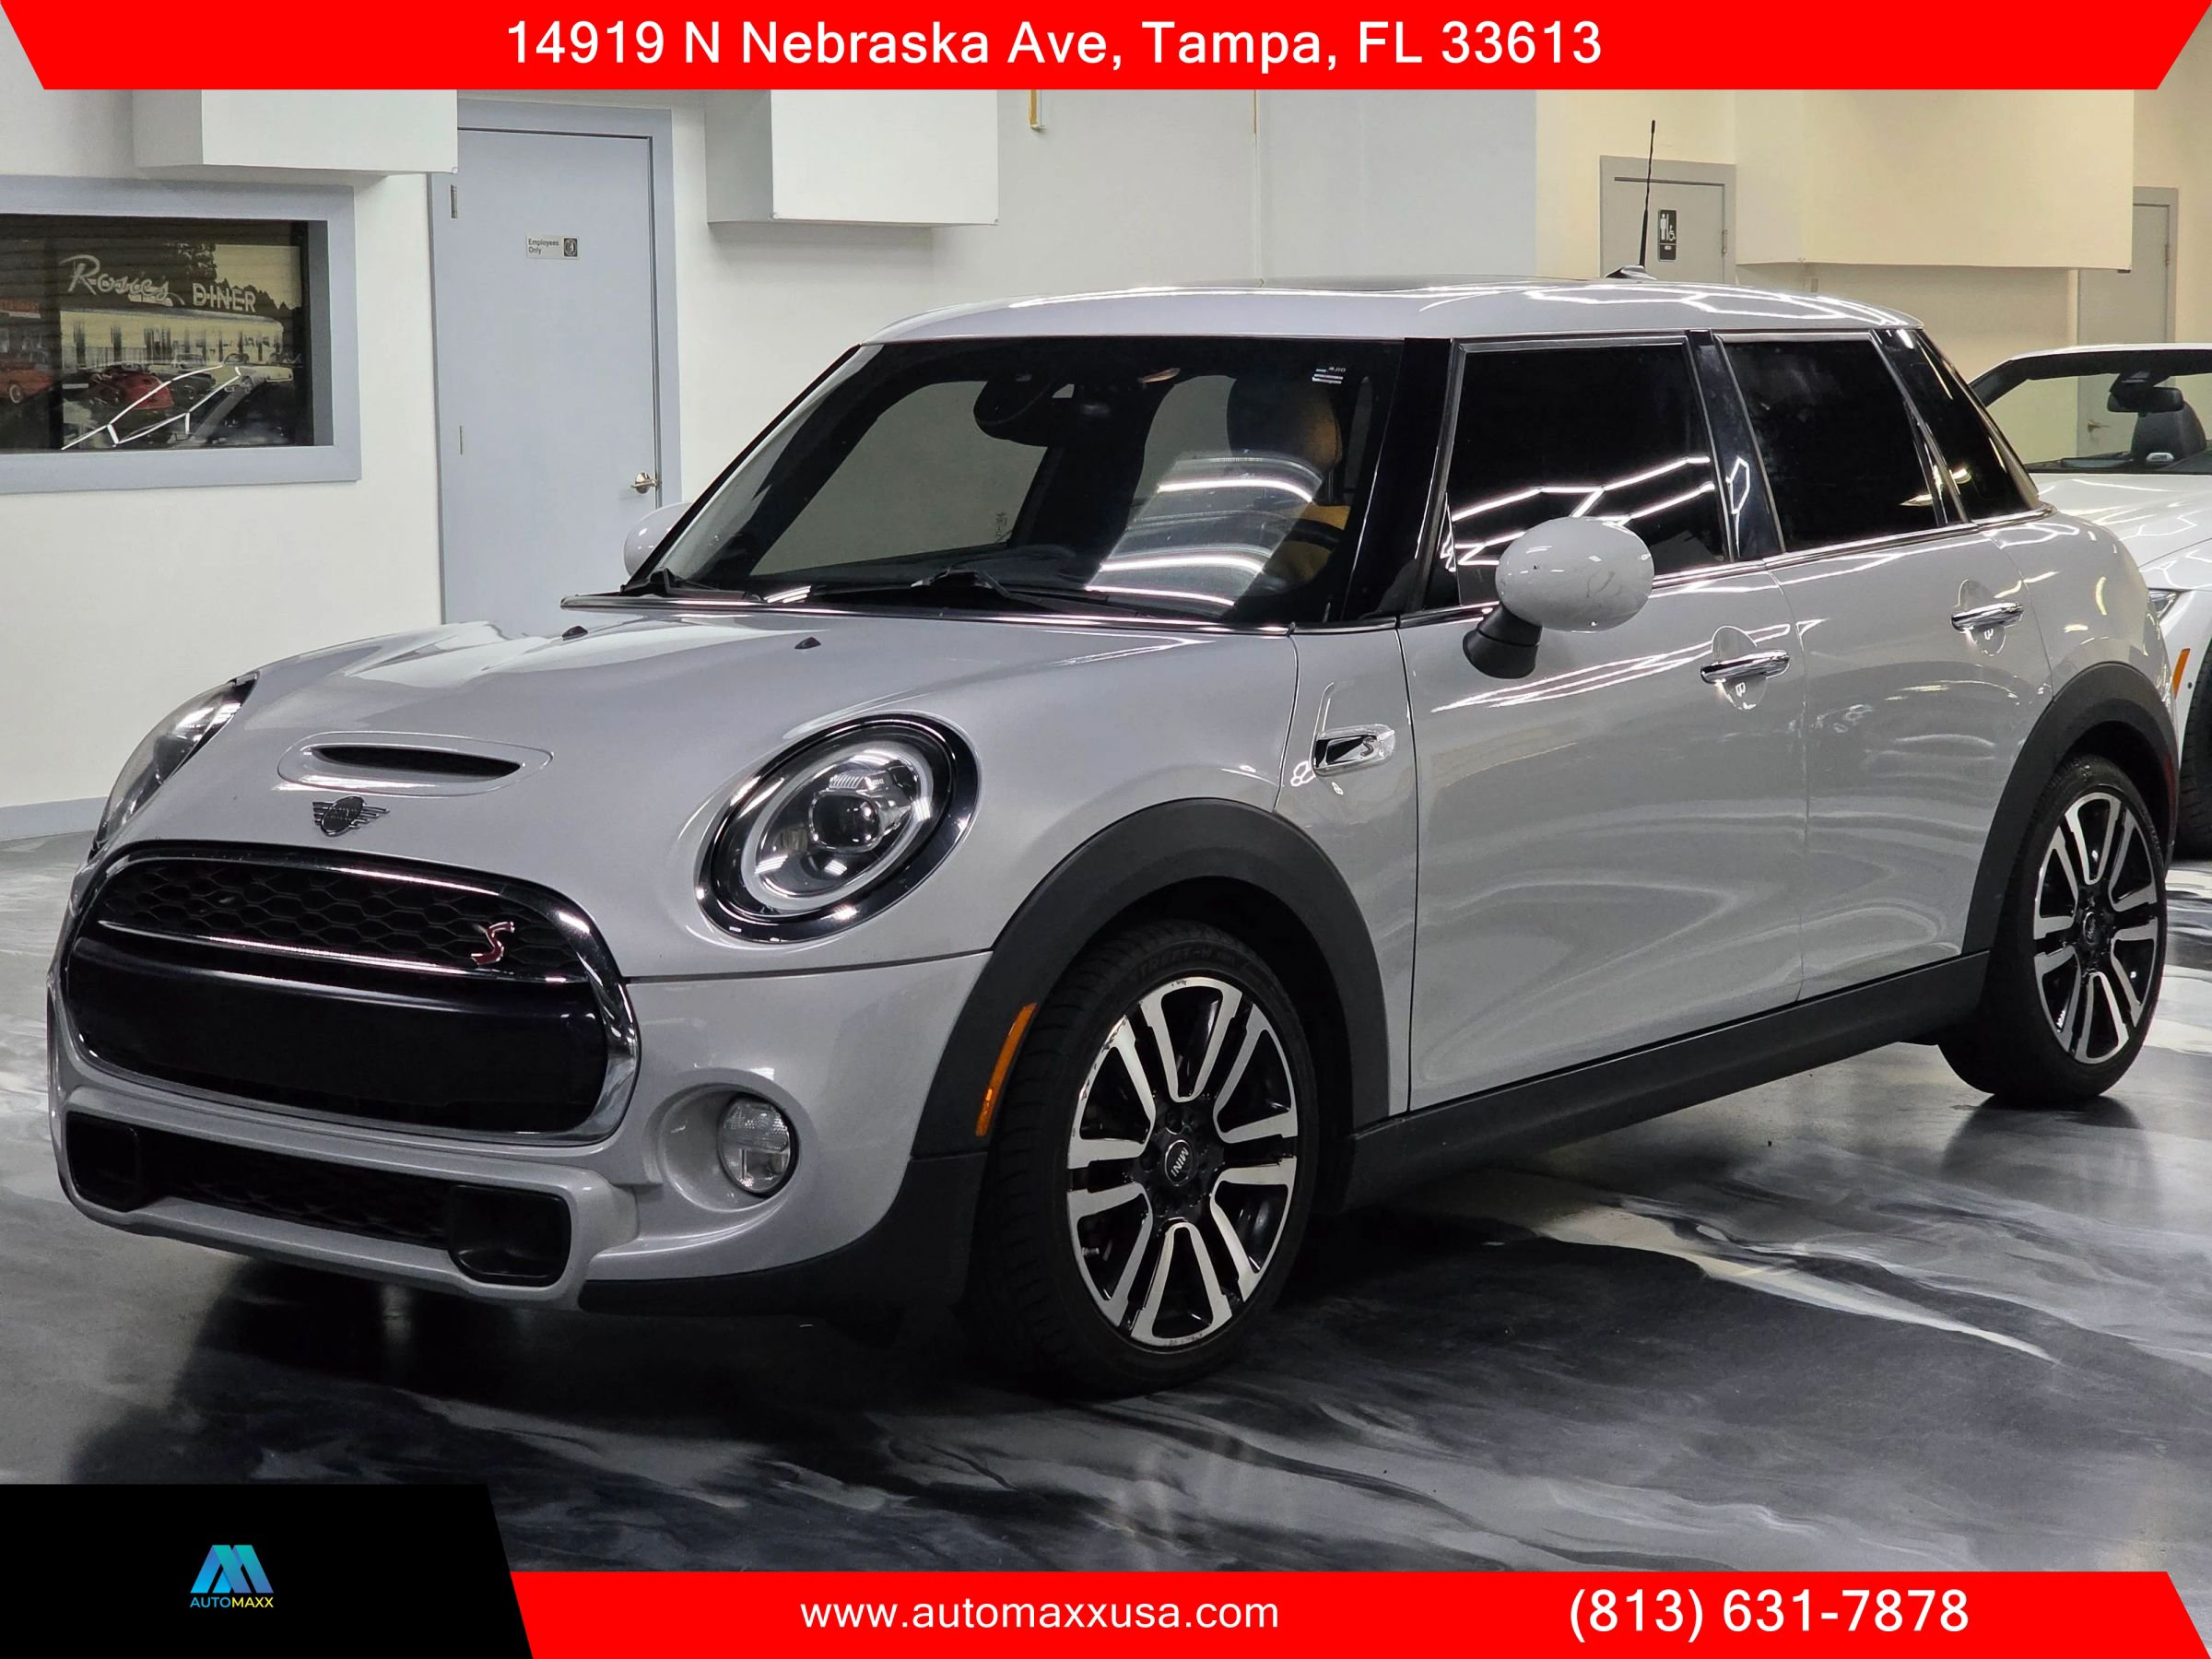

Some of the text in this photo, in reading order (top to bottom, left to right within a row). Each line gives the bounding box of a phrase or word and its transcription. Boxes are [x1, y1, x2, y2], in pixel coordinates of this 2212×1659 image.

[528, 238, 559, 247] Employees
[528, 246, 542, 255] Only
[192, 282, 256, 313] DINER
[470, 921, 515, 966] S
[1170, 1147, 1190, 1178] MINI
